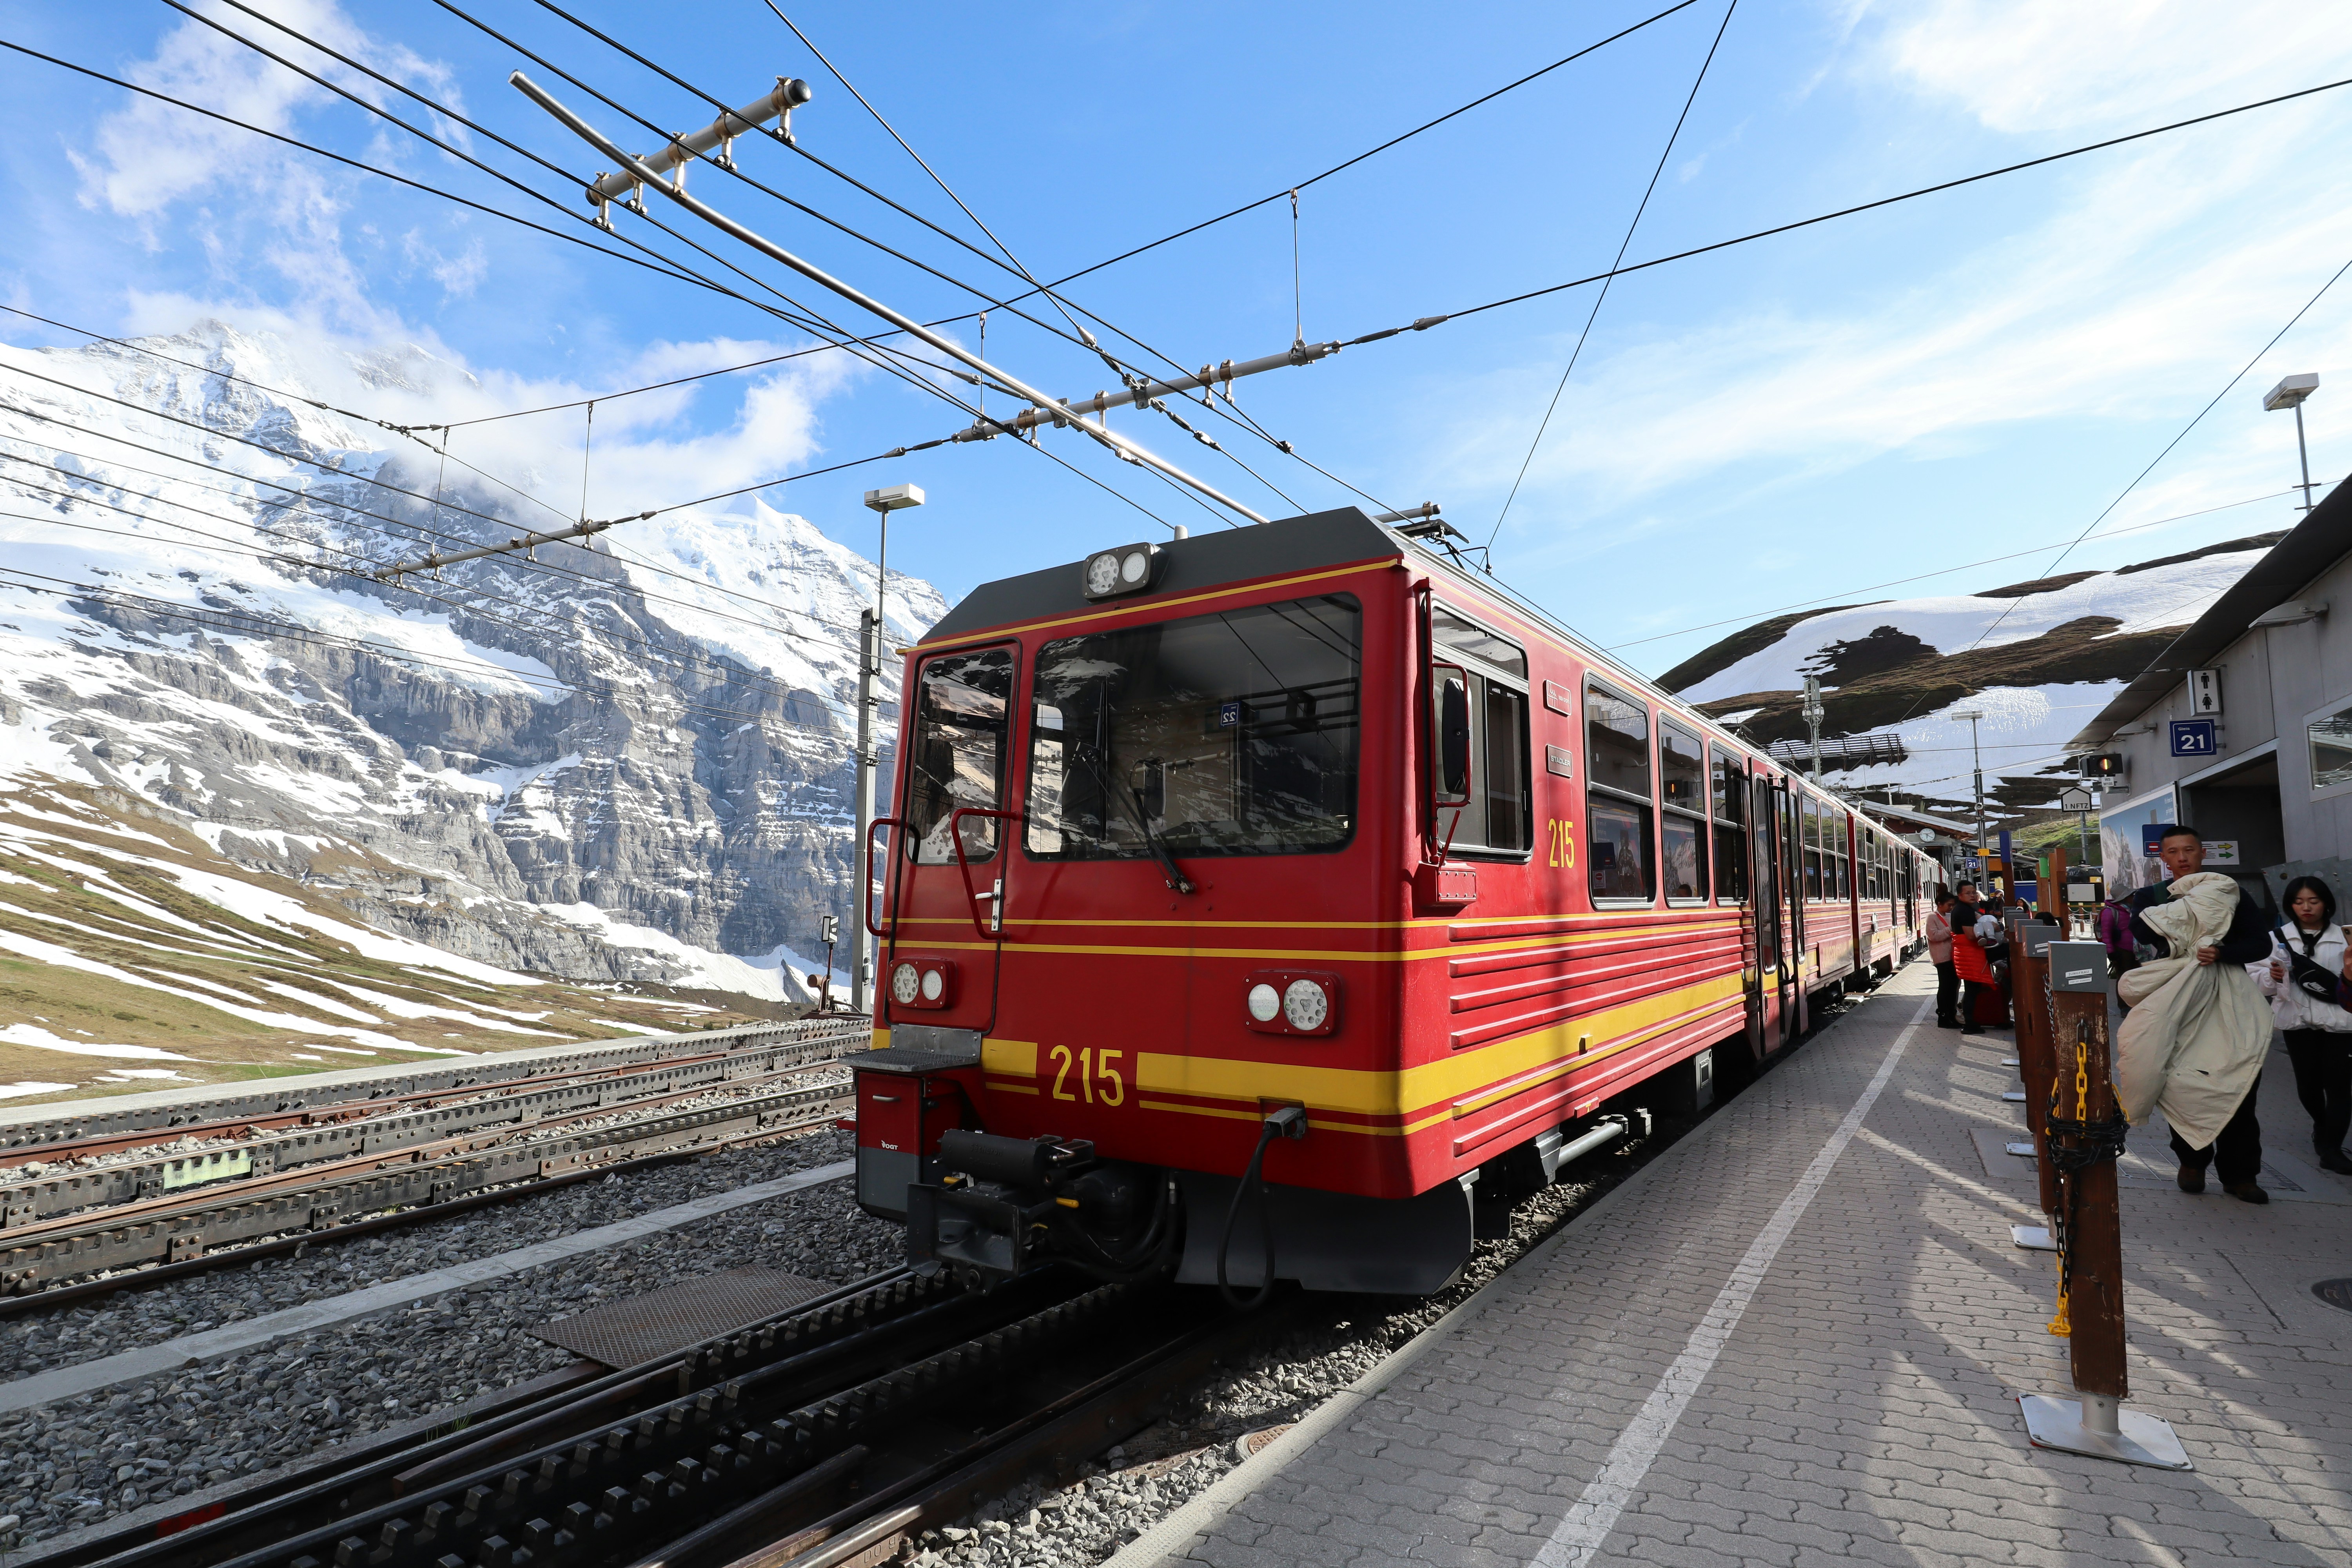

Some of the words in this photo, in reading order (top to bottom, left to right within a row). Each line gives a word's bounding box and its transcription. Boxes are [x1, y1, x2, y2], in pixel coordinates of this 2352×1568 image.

[2181, 734, 2204, 750] 21
[1550, 755, 1570, 767] STADLER
[1548, 818, 1574, 869] 215
[2309, 982, 2327, 991] NIKE
[1050, 1045, 1124, 1106] 215
[881, 1140, 898, 1150] VOGT
